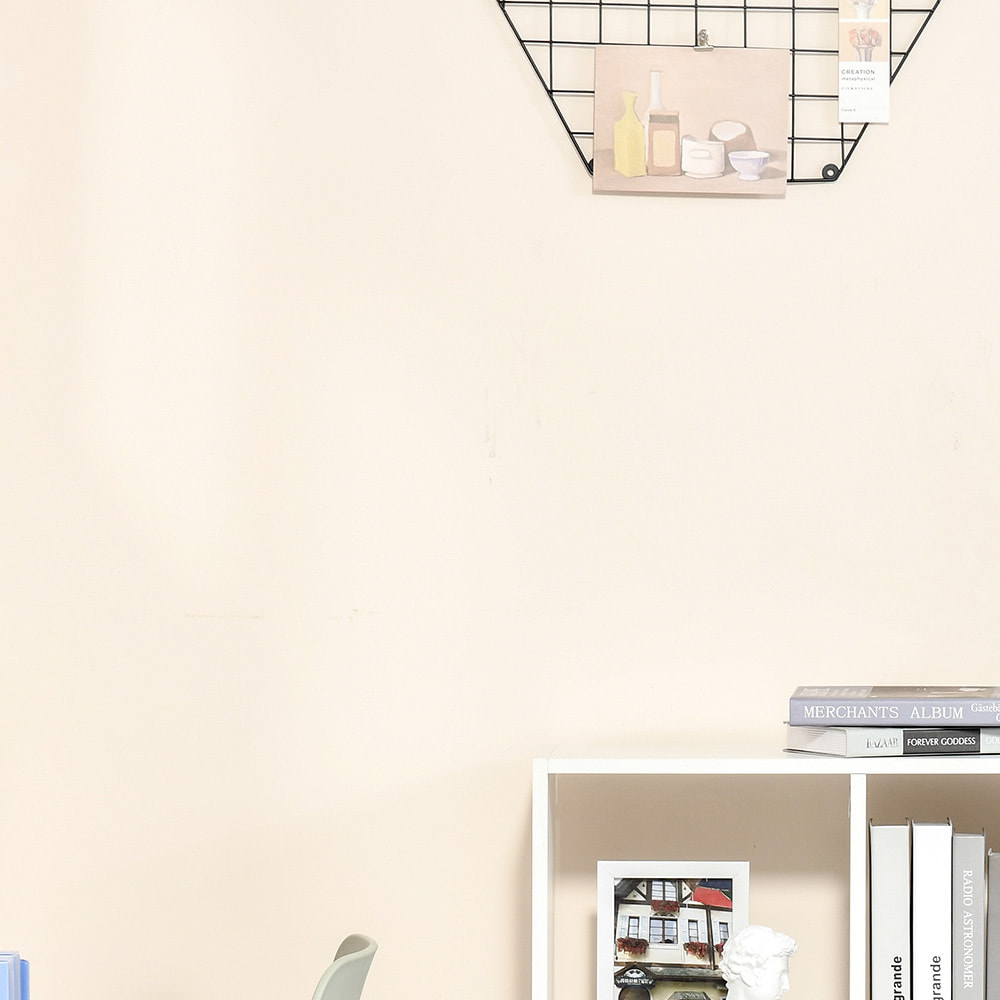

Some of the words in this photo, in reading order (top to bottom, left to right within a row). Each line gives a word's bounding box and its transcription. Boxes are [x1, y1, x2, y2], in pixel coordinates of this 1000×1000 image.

[804, 706, 900, 719] MERCHANTS
[910, 706, 964, 719] ALBUM
[906, 738, 939, 747] FOREVER
[940, 736, 977, 746] GODDESS
[962, 869, 973, 906] RADIO
[962, 910, 973, 989] ASTRONOMER
